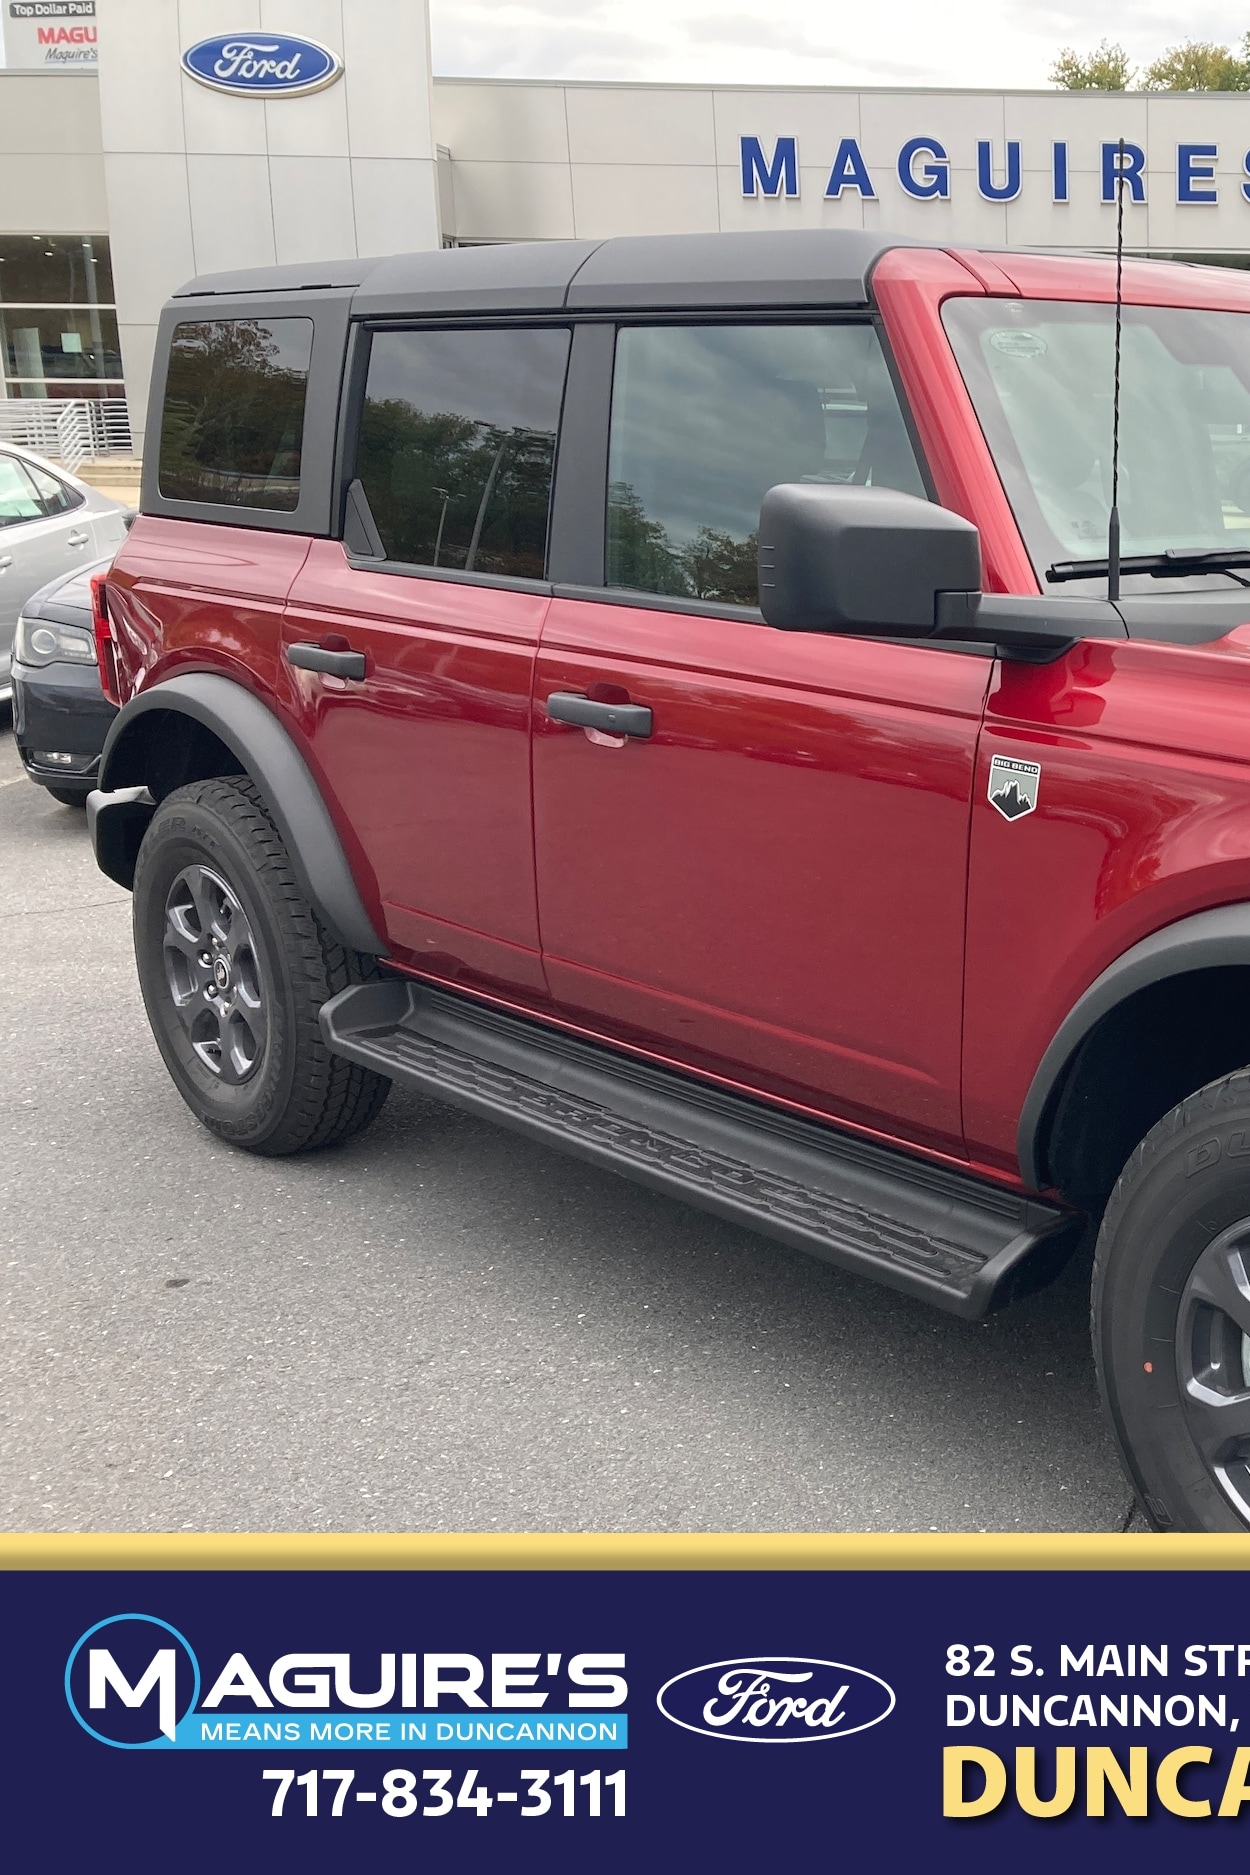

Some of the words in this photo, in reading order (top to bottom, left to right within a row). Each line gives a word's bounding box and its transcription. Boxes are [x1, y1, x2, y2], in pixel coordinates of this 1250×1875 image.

[14, 4, 34, 16] Top
[35, 3, 67, 15] Dollar
[68, 2, 93, 14] Paid
[214, 42, 302, 79] Ford
[994, 759, 1010, 767] BIG
[1012, 763, 1038, 773] BEND
